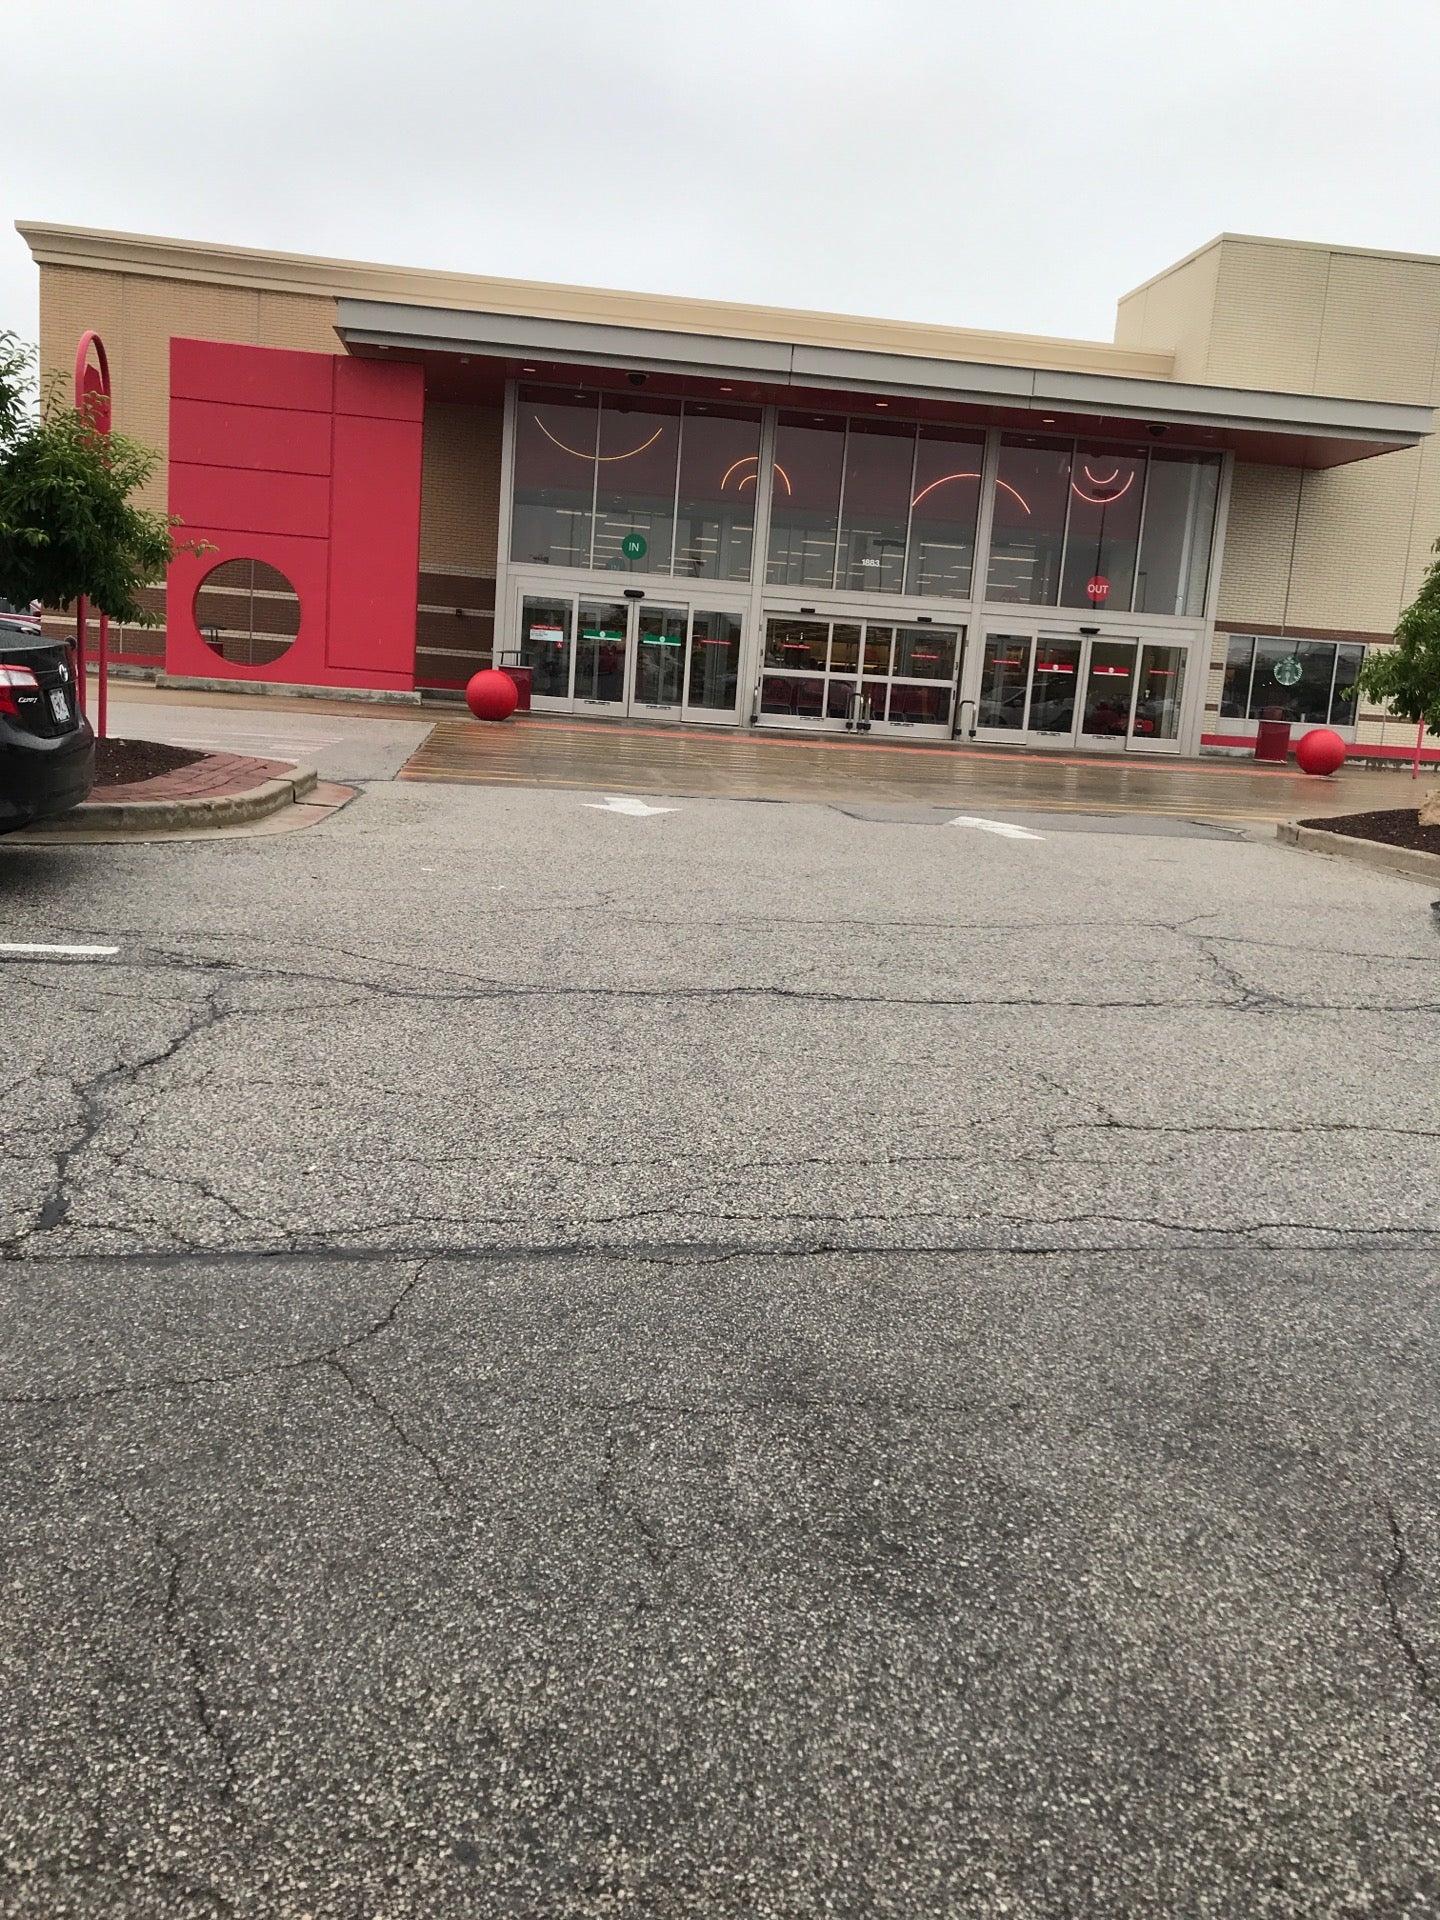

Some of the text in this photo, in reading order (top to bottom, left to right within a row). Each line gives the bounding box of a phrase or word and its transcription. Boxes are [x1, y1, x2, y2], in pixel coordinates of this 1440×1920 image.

[628, 542, 640, 552] IN
[861, 558, 880, 567] 1883
[1087, 584, 1109, 594] OUT
